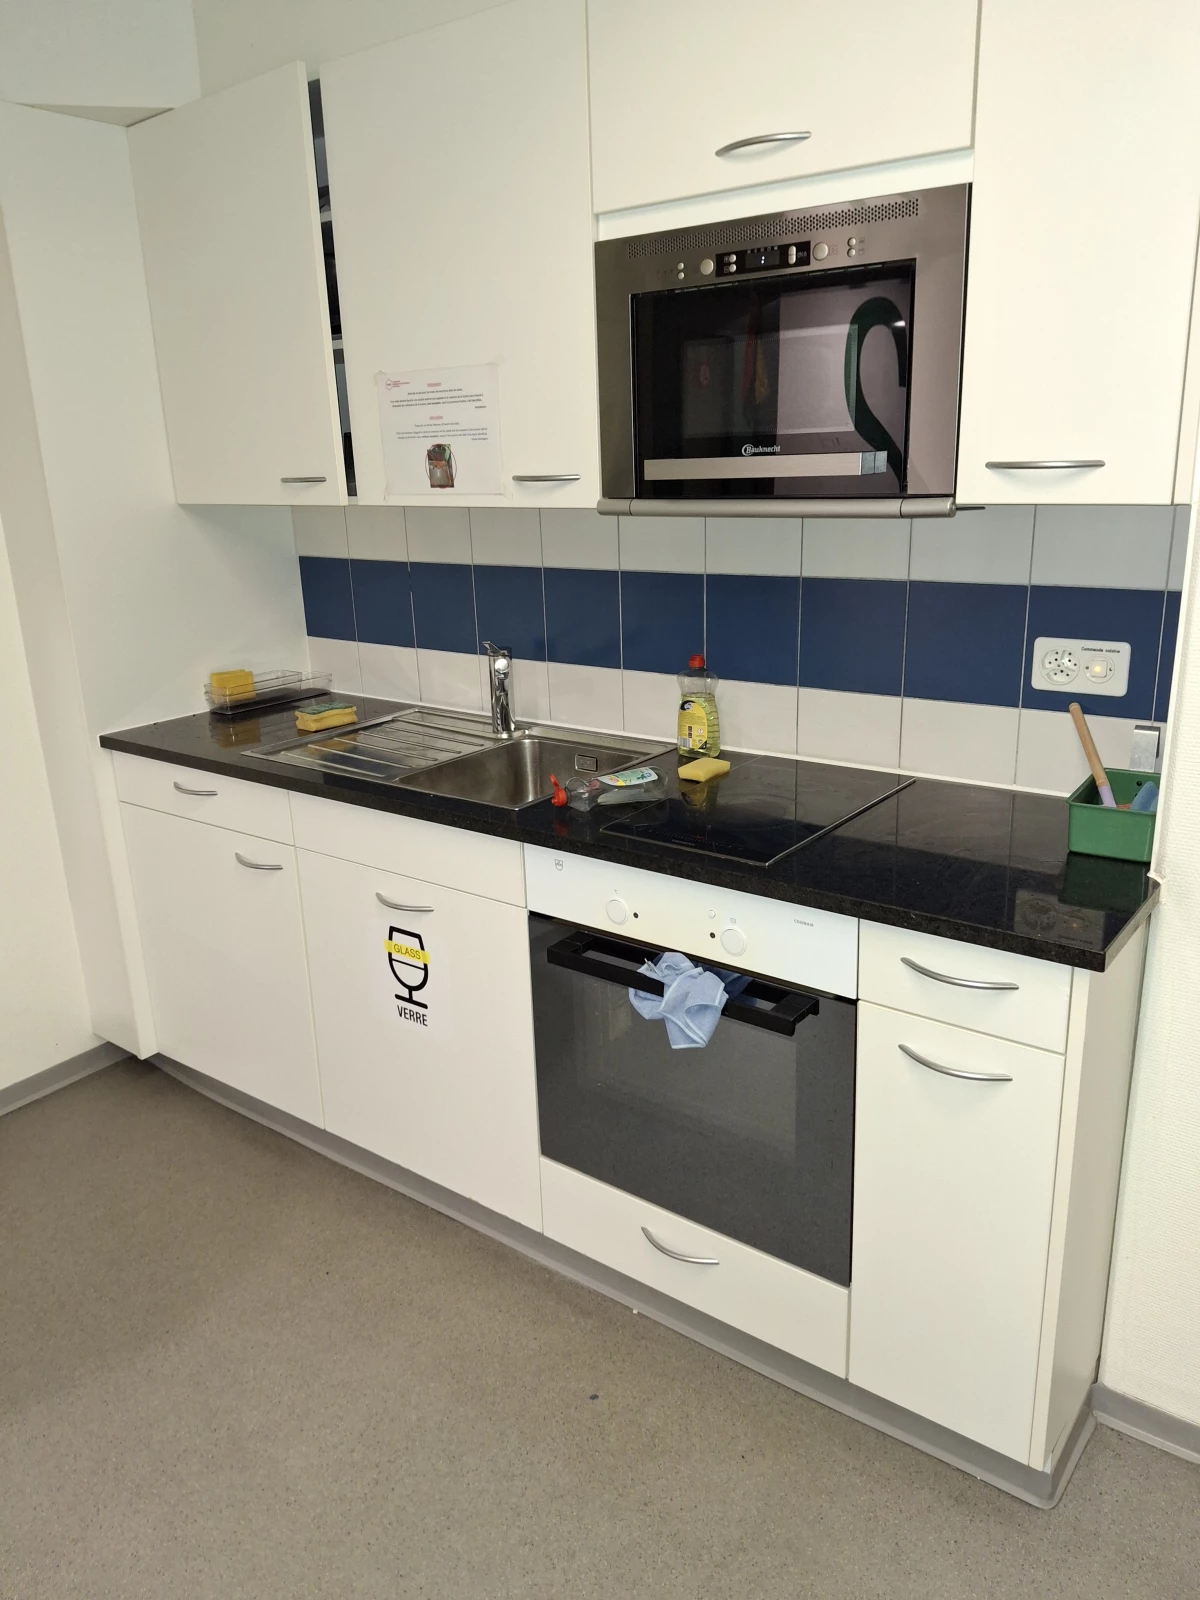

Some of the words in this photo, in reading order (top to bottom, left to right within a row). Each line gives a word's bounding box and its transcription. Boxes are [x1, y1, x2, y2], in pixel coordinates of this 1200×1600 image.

[741, 443, 781, 456] Bauknecht
[393, 943, 421, 960] GLASS
[397, 1004, 428, 1027] VERRE
